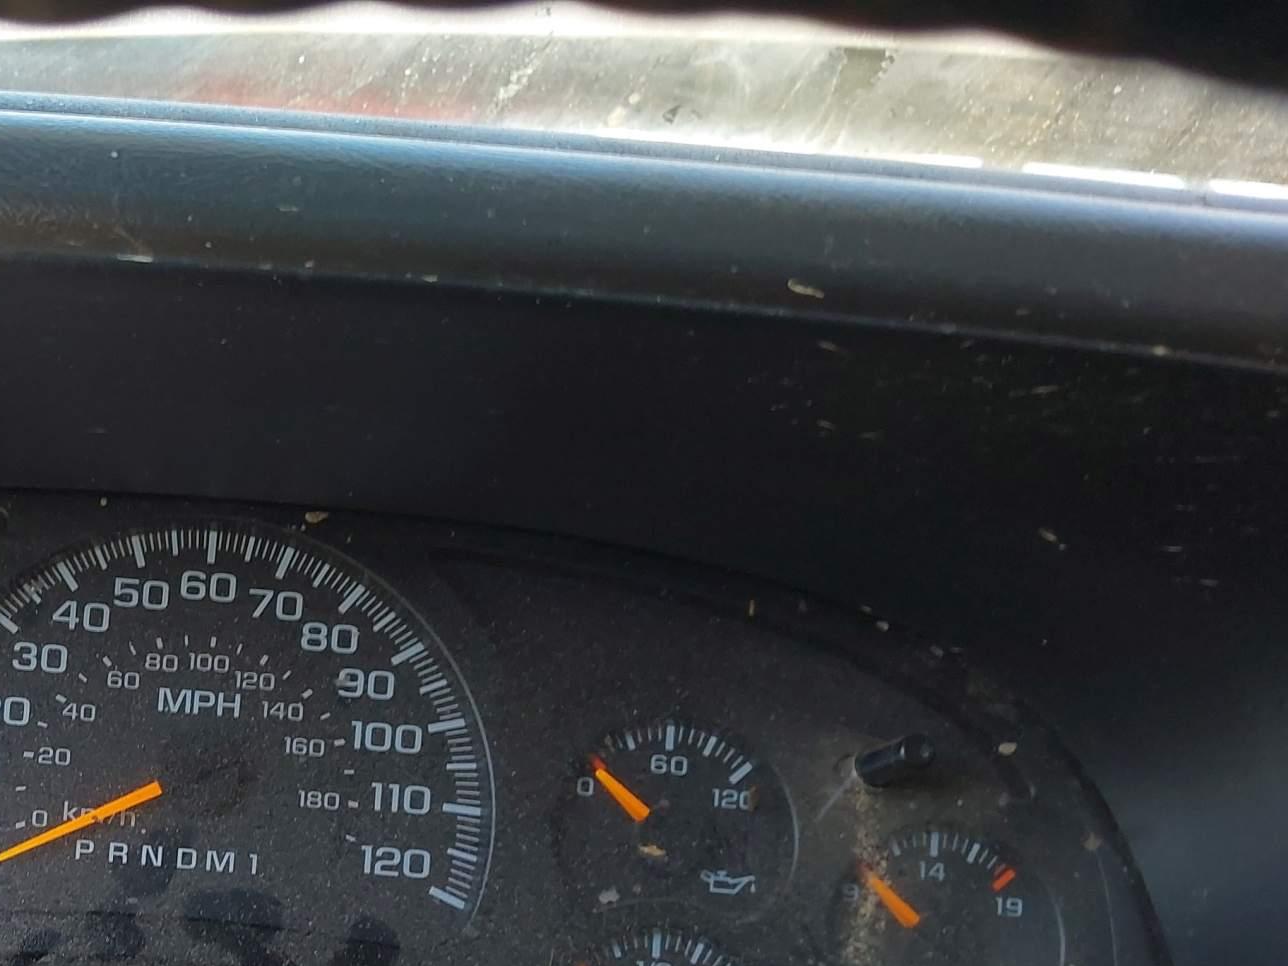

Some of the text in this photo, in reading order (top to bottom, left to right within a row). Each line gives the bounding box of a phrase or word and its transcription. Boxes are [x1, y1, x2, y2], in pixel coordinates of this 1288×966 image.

[113, 577, 170, 611] 50
[180, 570, 237, 603] 60
[249, 588, 304, 621] 70
[52, 600, 111, 632] 40
[301, 621, 360, 655] 80
[12, 641, 68, 674] 30
[144, 652, 179, 673] 80
[189, 652, 230, 673] 100
[106, 670, 141, 690] 60
[234, 670, 275, 691] 120
[337, 667, 395, 701] 90
[62, 702, 96, 722] 40
[157, 687, 242, 719] MPH
[262, 700, 304, 721] 140
[283, 736, 326, 758] 160
[352, 720, 423, 754] 100
[37, 746, 71, 767] 20
[650, 754, 688, 777] 60
[577, 777, 595, 797] 0
[298, 789, 340, 811] 180
[372, 782, 431, 815] 110
[712, 787, 754, 811] 120
[32, 809, 48, 828] 0
[361, 844, 432, 879] 120
[919, 861, 946, 882] 14
[994, 896, 1023, 918] 19
